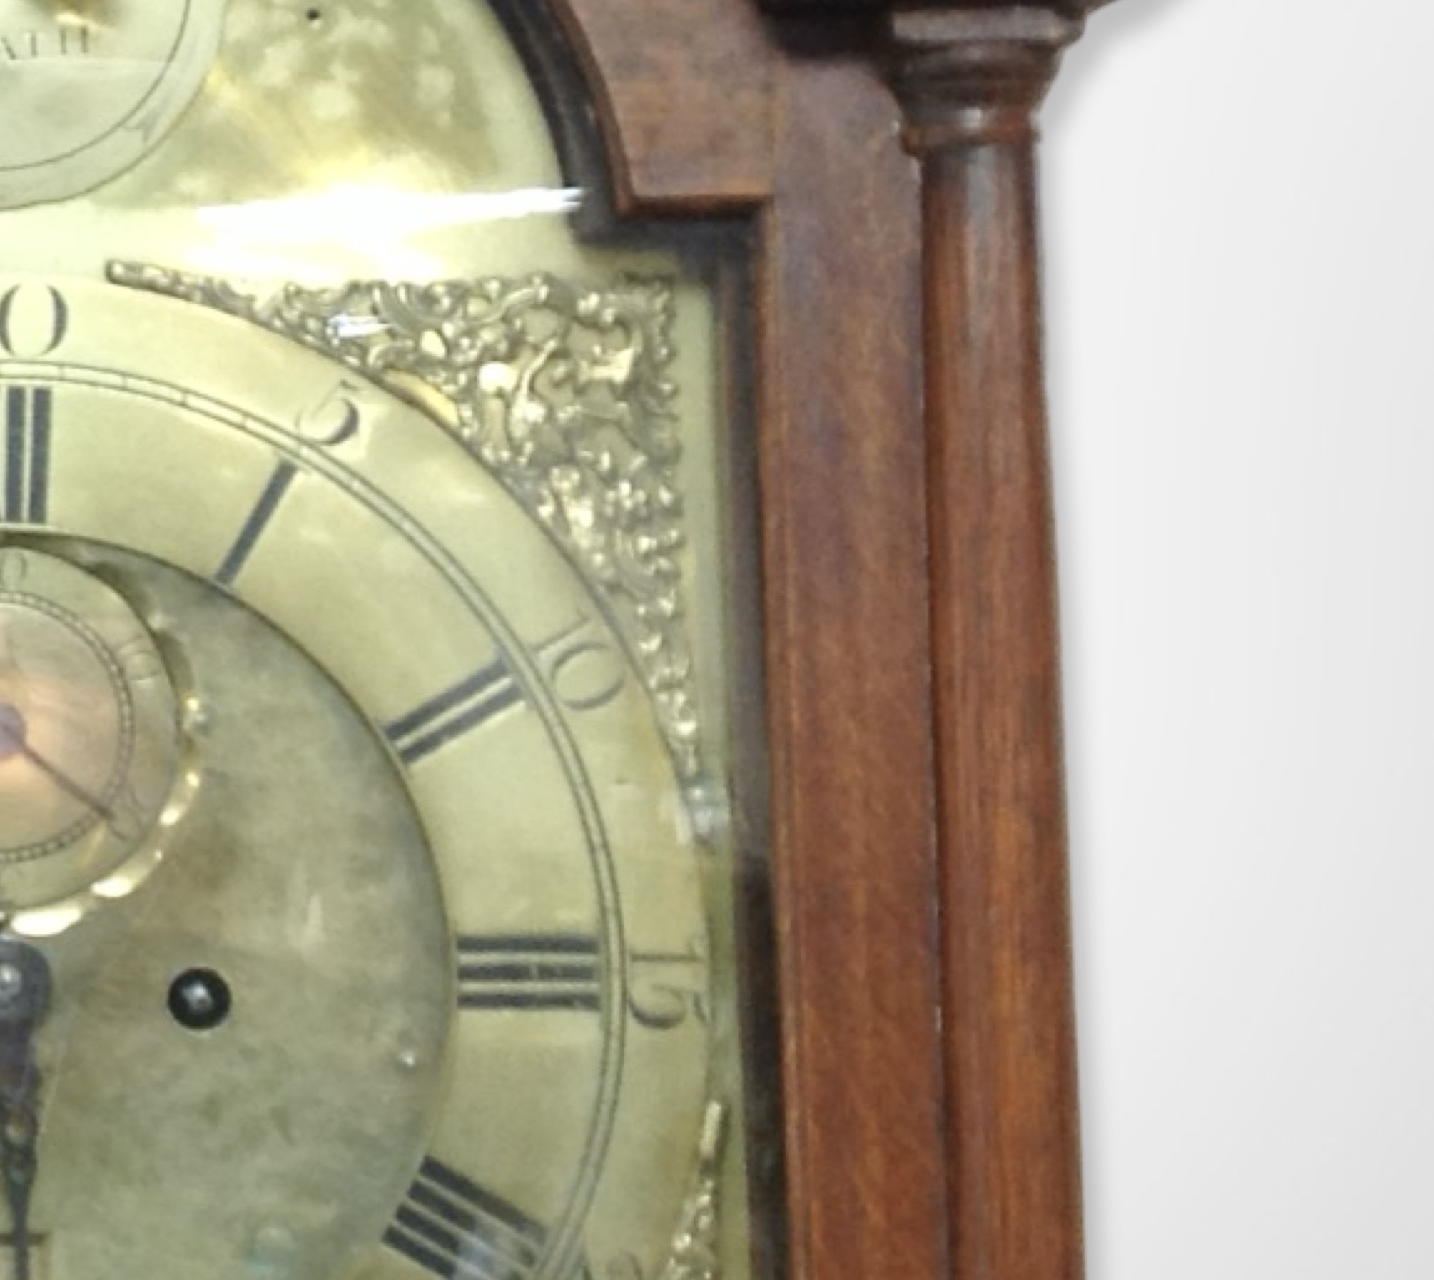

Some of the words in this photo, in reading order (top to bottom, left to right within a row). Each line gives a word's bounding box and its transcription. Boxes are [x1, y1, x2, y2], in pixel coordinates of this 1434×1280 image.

[302, 378, 362, 446] 5
[216, 458, 298, 587] I
[383, 650, 528, 765] II
[530, 613, 626, 713] 10
[456, 933, 602, 1012] III
[623, 933, 709, 1031] 15
